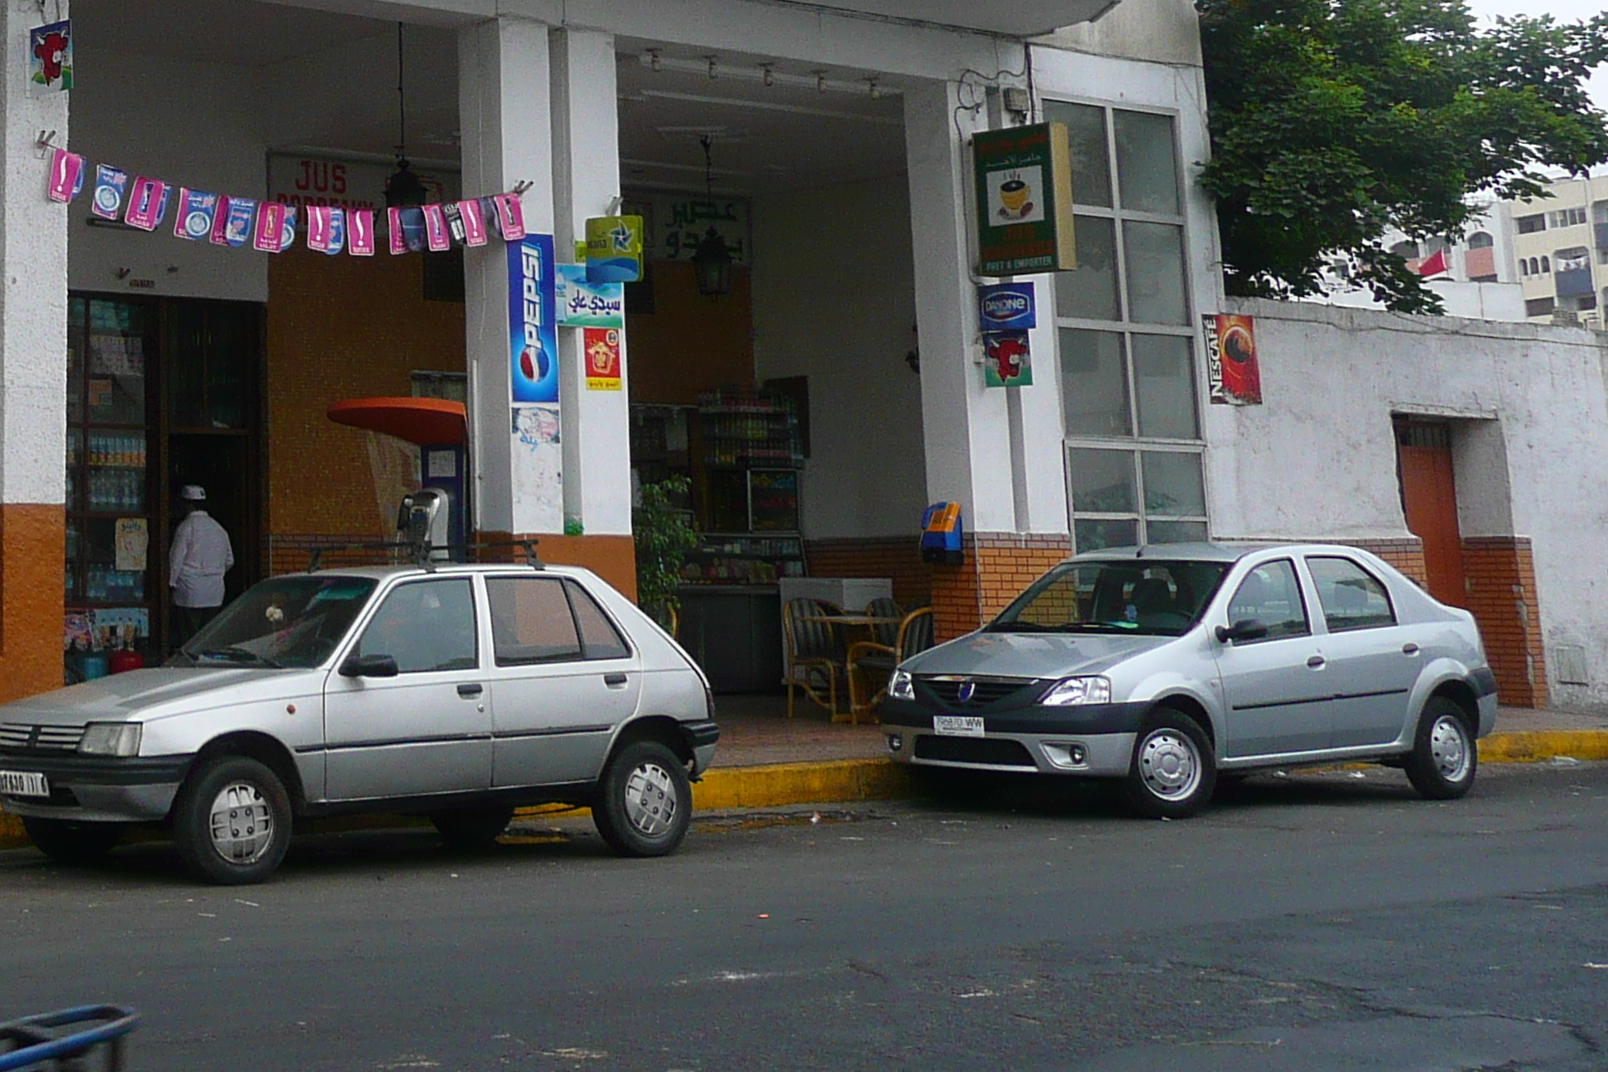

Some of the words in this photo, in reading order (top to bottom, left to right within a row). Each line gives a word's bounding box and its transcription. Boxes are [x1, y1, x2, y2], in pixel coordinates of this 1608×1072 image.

[296, 160, 347, 194] JUS
[521, 244, 544, 349] PEPSI
[568, 288, 588, 314] علي
[588, 294, 621, 316] سيدي
